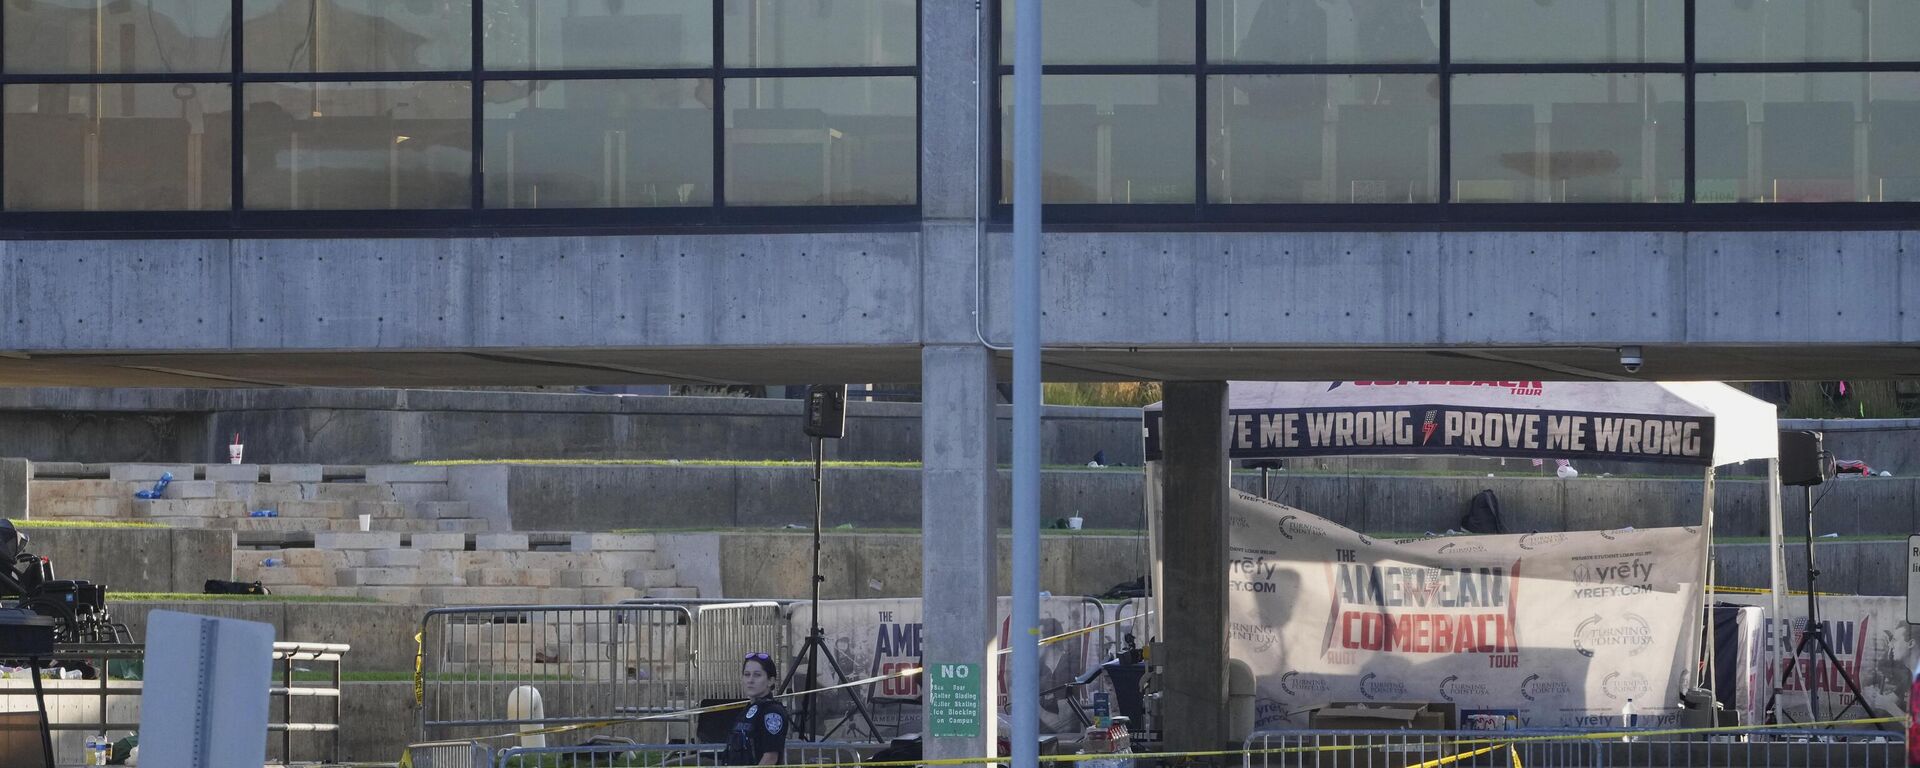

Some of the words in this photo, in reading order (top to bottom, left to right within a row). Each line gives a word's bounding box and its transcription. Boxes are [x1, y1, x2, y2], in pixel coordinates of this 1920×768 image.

[1510, 388, 1543, 396] TOUR
[1260, 412, 1299, 448] ME
[1306, 410, 1413, 447] WRONG
[1444, 410, 1541, 449] PROVE
[1546, 415, 1587, 451] ME
[1594, 417, 1700, 456] WRONG
[1336, 549, 1356, 562] THE
[1574, 583, 1653, 598] YREFY.COM
[879, 611, 893, 623] THE
[1342, 610, 1519, 654] COMEBACK
[1591, 626, 1649, 637] TURNING
[1489, 655, 1519, 668] TOUR
[941, 664, 969, 678] NO
[955, 692, 977, 700] Blading
[948, 717, 973, 725] Campus
